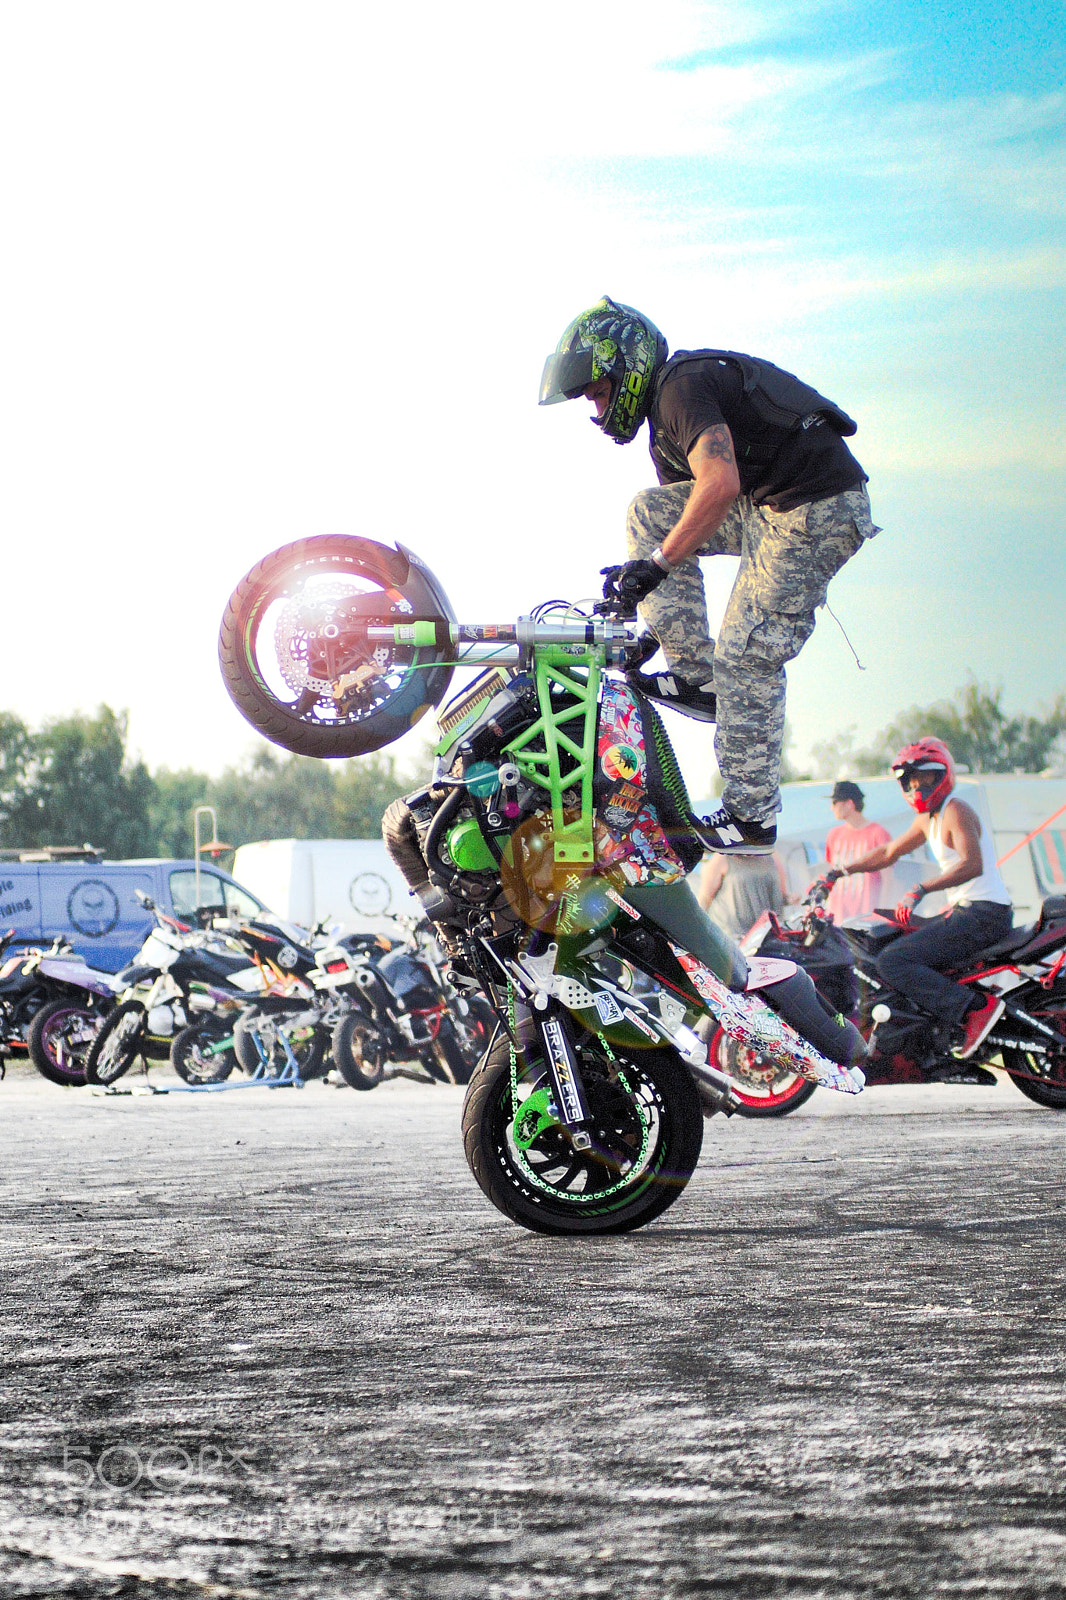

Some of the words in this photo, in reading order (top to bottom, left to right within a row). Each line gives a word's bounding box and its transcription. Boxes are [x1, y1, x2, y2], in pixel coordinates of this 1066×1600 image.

[294, 556, 366, 571] ENERGY
[657, 676, 679, 696] N
[715, 823, 744, 846] N
[613, 896, 639, 920] brembo
[632, 1016, 658, 1041] brembo
[545, 1022, 581, 1121] BRAZZERS
[619, 1057, 666, 1114] ENERGY
[497, 1146, 541, 1203] ENERGY
